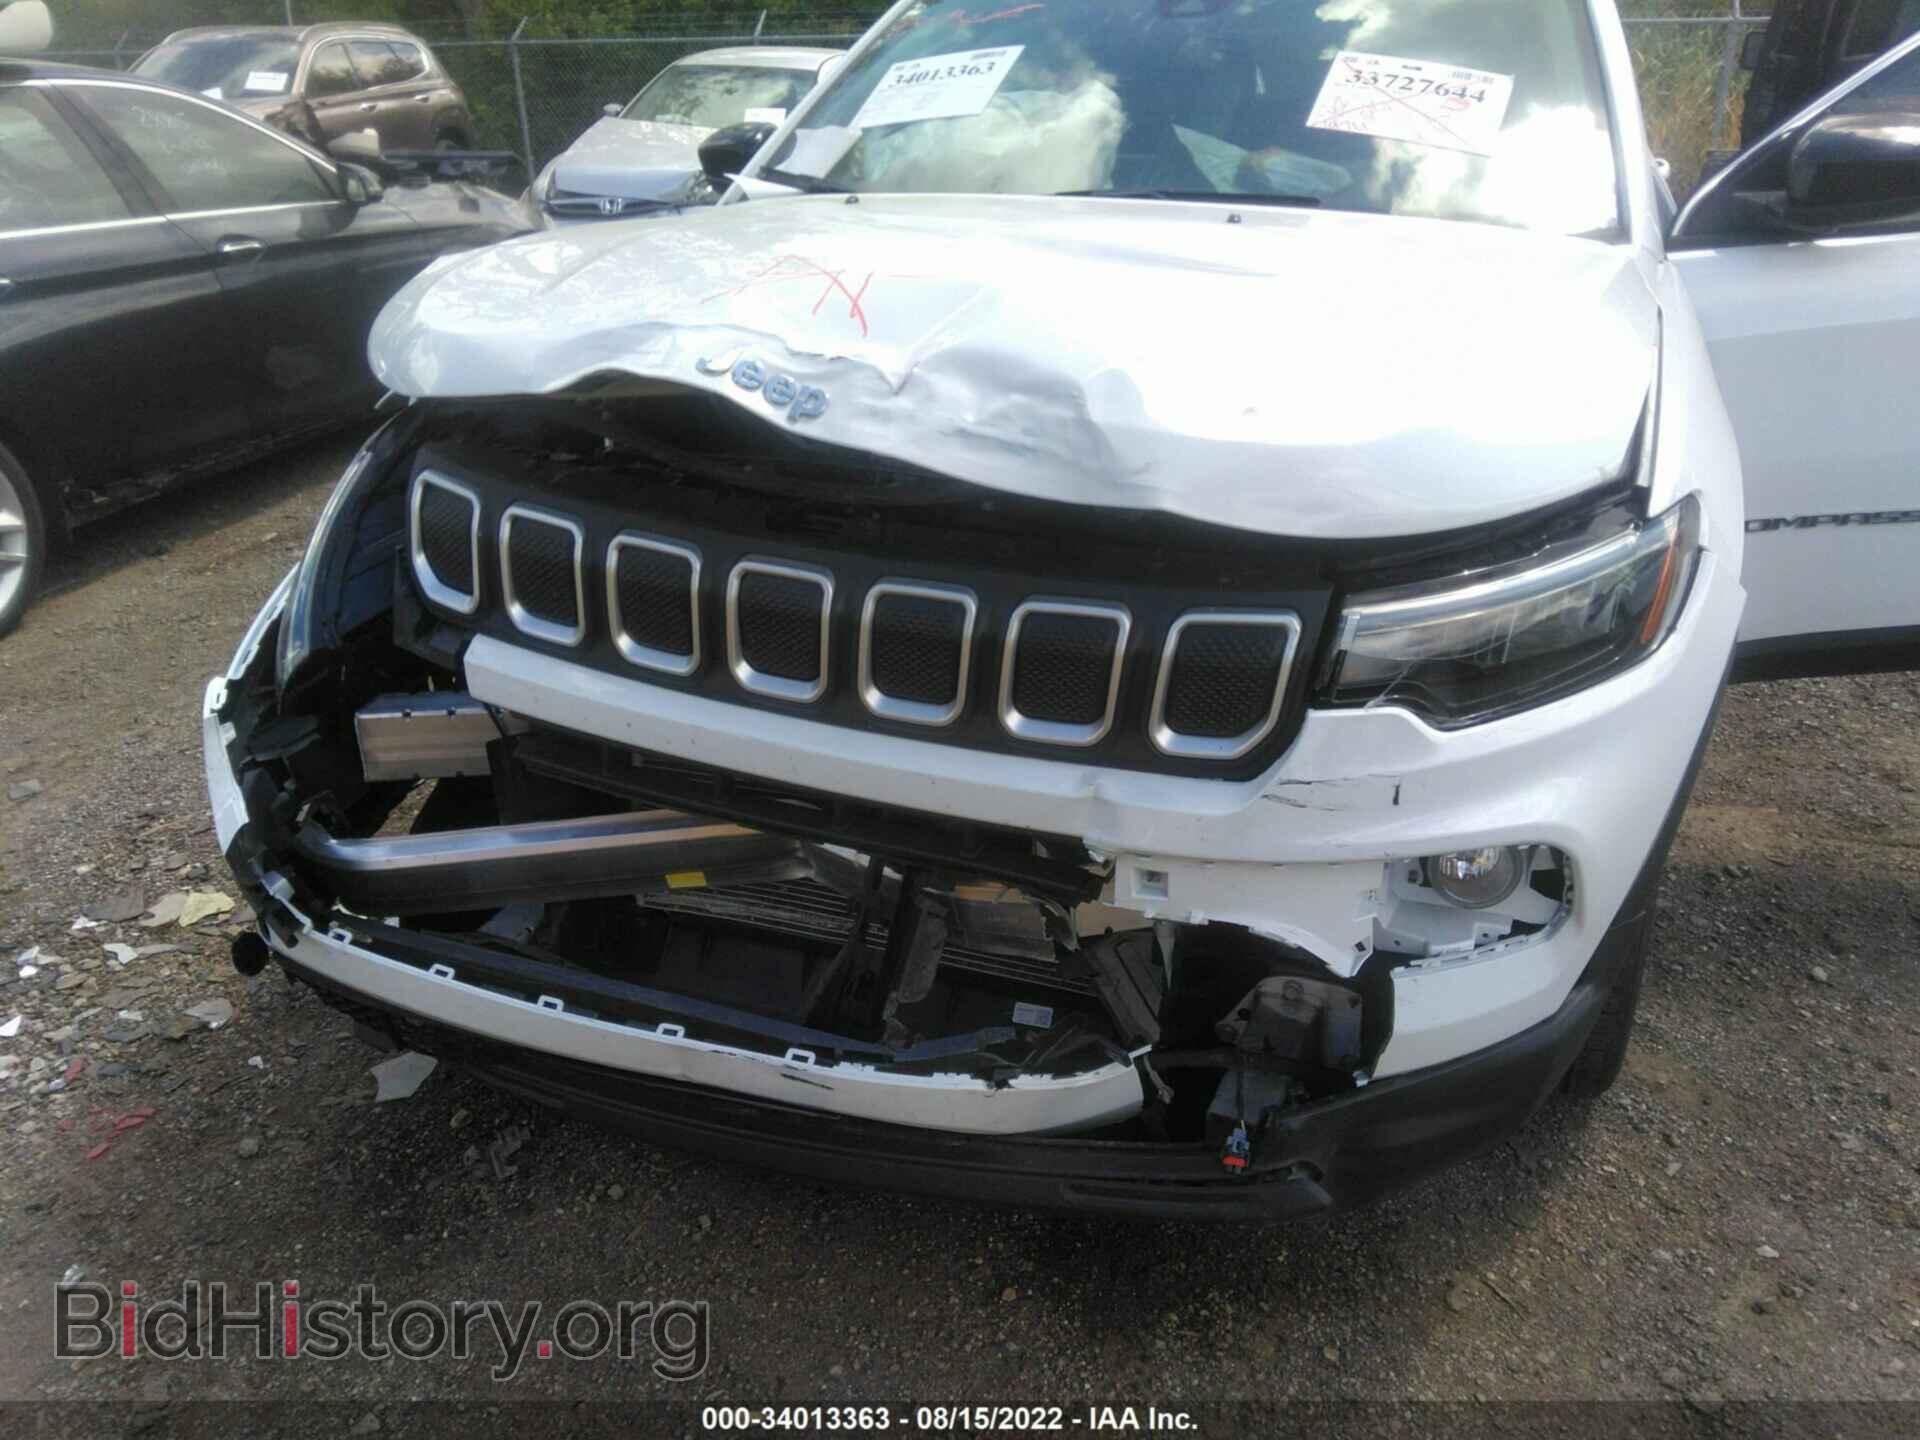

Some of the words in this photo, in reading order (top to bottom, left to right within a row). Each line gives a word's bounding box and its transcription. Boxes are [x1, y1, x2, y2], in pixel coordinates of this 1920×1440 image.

[889, 62, 996, 88] 34013363
[1344, 69, 1486, 103] 33727644
[695, 351, 829, 425] Jeep
[1744, 510, 1920, 533] OMPASS
